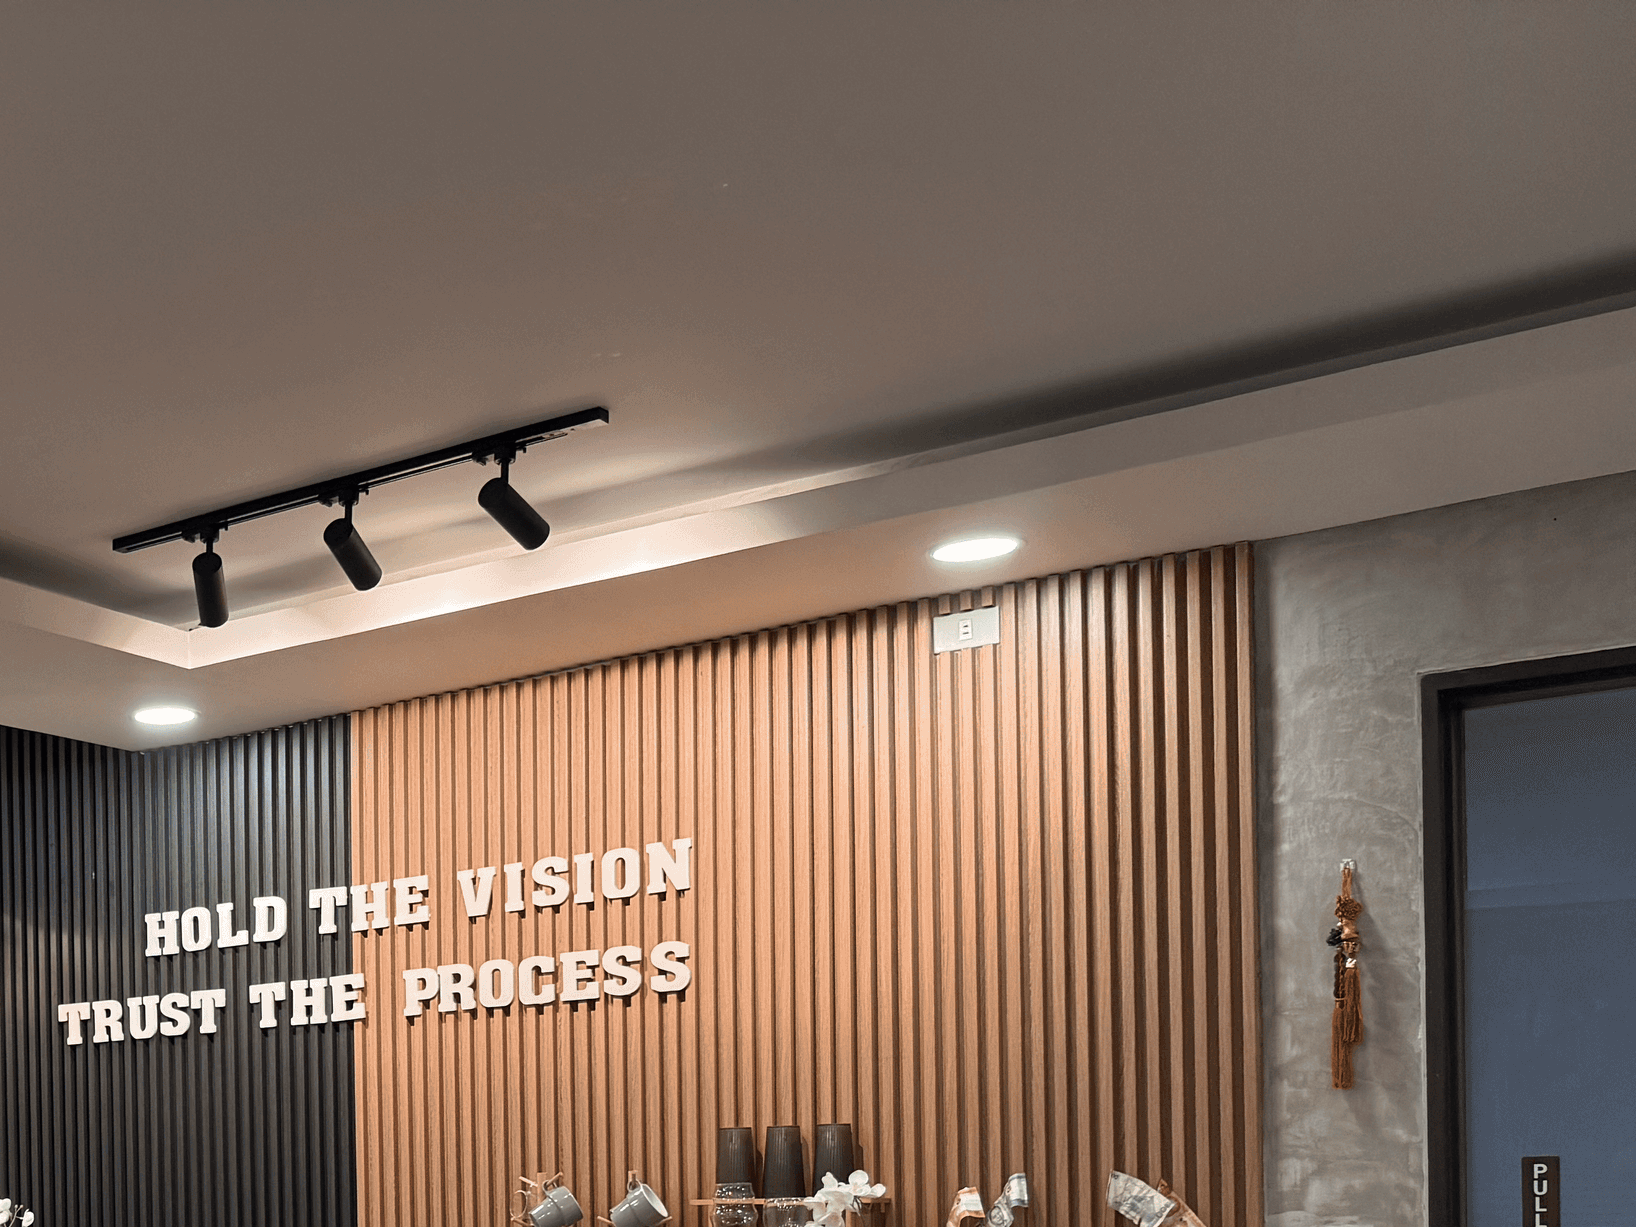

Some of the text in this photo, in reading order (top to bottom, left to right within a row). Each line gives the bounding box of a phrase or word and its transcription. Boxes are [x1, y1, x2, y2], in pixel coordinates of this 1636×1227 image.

[144, 837, 693, 957] HOLD THE VISION
[57, 940, 692, 1046] TRUST THE PROCESS
